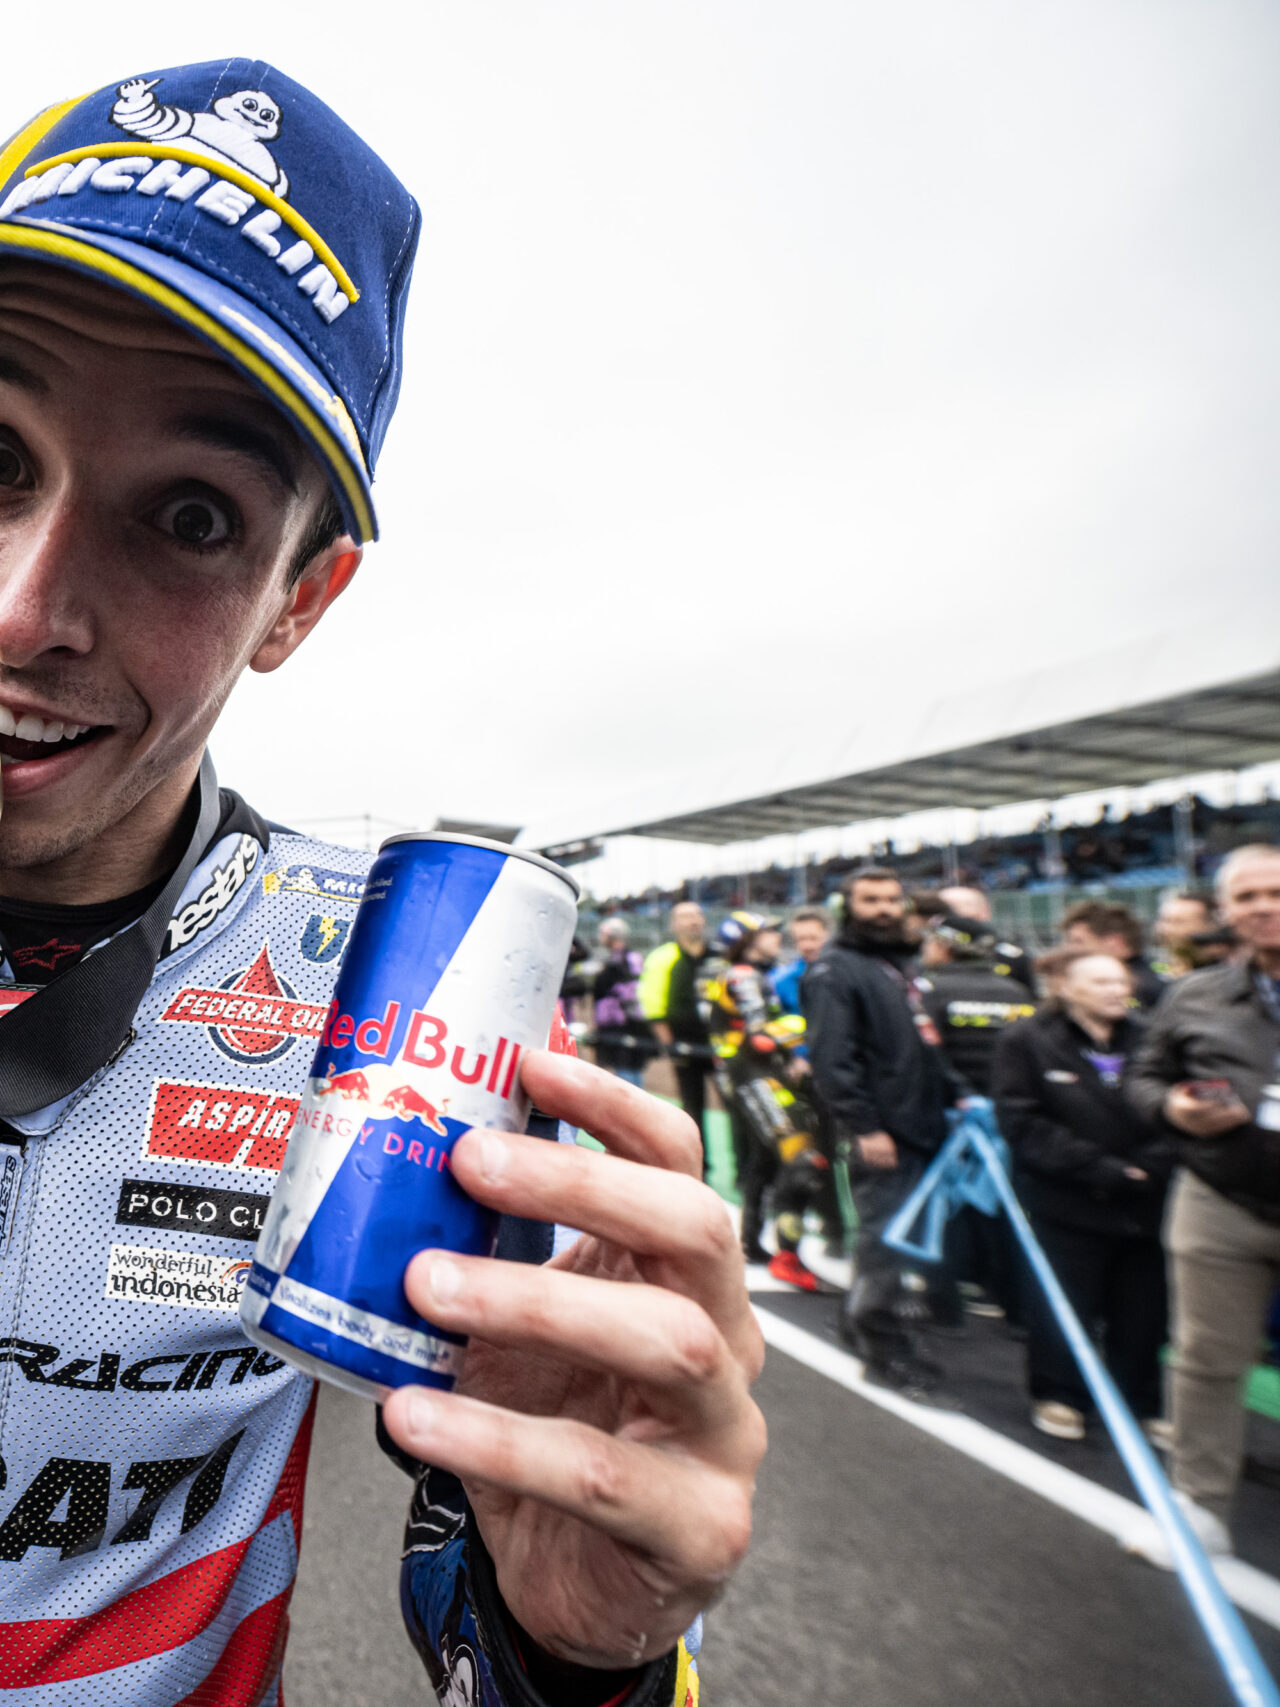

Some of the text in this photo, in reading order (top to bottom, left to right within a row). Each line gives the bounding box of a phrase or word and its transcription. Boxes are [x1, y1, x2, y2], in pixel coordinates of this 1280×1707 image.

[175, 993, 283, 1025] FEDERAL
[319, 999, 521, 1100] Red Bull
[177, 1096, 292, 1140] ASPIR
[296, 1107, 374, 1145] ENERGY
[128, 1193, 217, 1222] POLO
[116, 1253, 212, 1275] wonderful
[111, 1271, 242, 1303] indonesia
